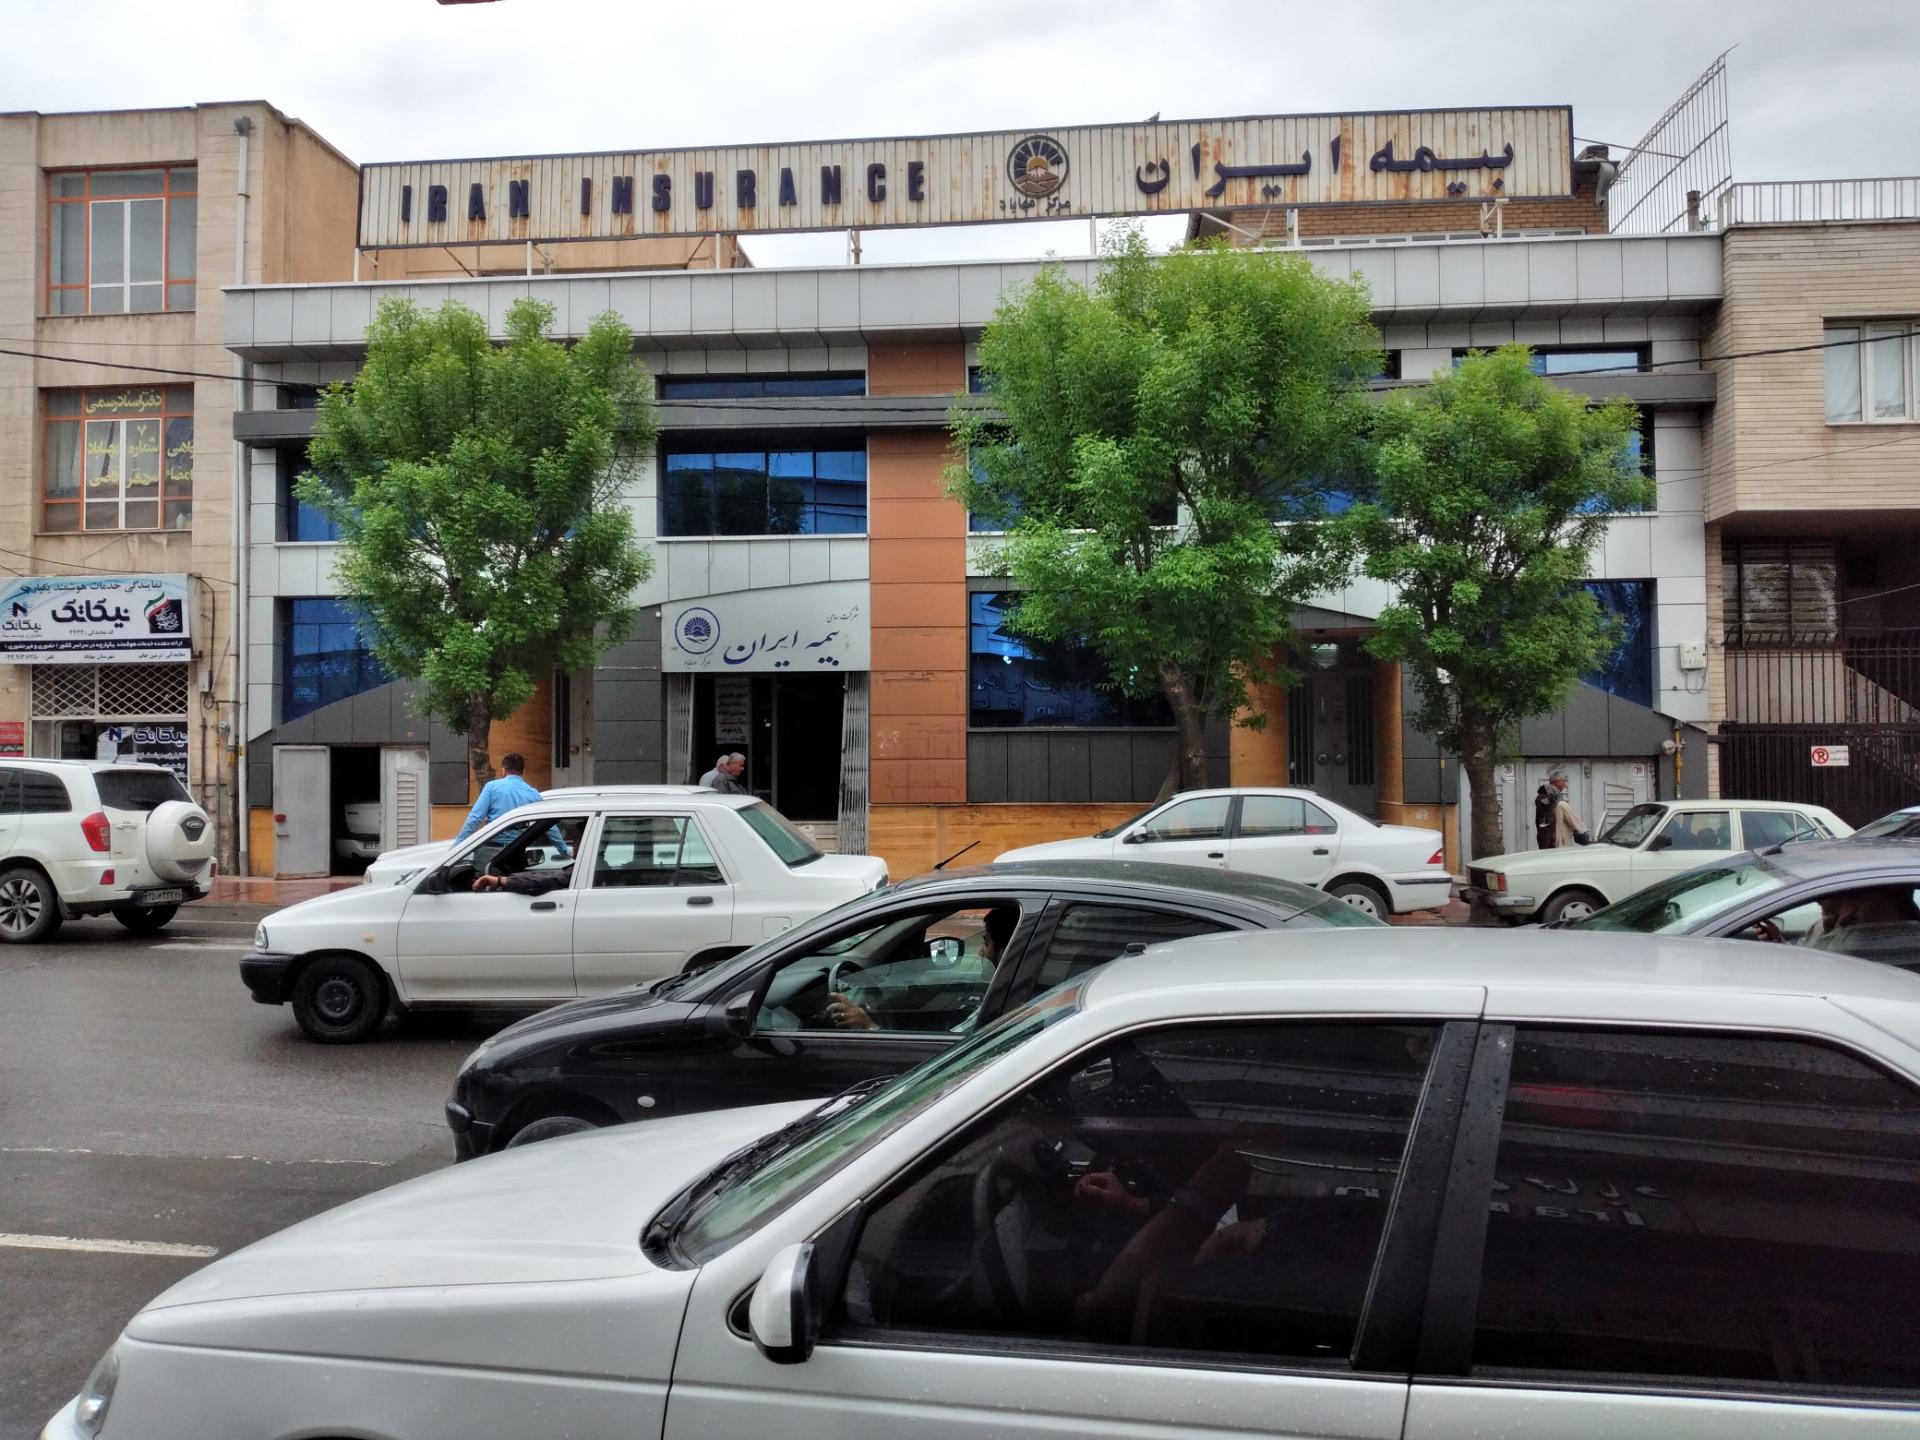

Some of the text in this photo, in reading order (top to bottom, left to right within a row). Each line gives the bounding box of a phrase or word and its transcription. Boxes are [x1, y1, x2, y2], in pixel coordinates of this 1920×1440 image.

[1135, 133, 1514, 199] بیمه ایران
[401, 161, 925, 222] IRAN INSURANCE
[55, 583, 87, 594] هوشمند
[89, 581, 121, 590] خدمات
[51, 598, 131, 629] نیکاتک
[722, 629, 841, 669] بیمه ایران
